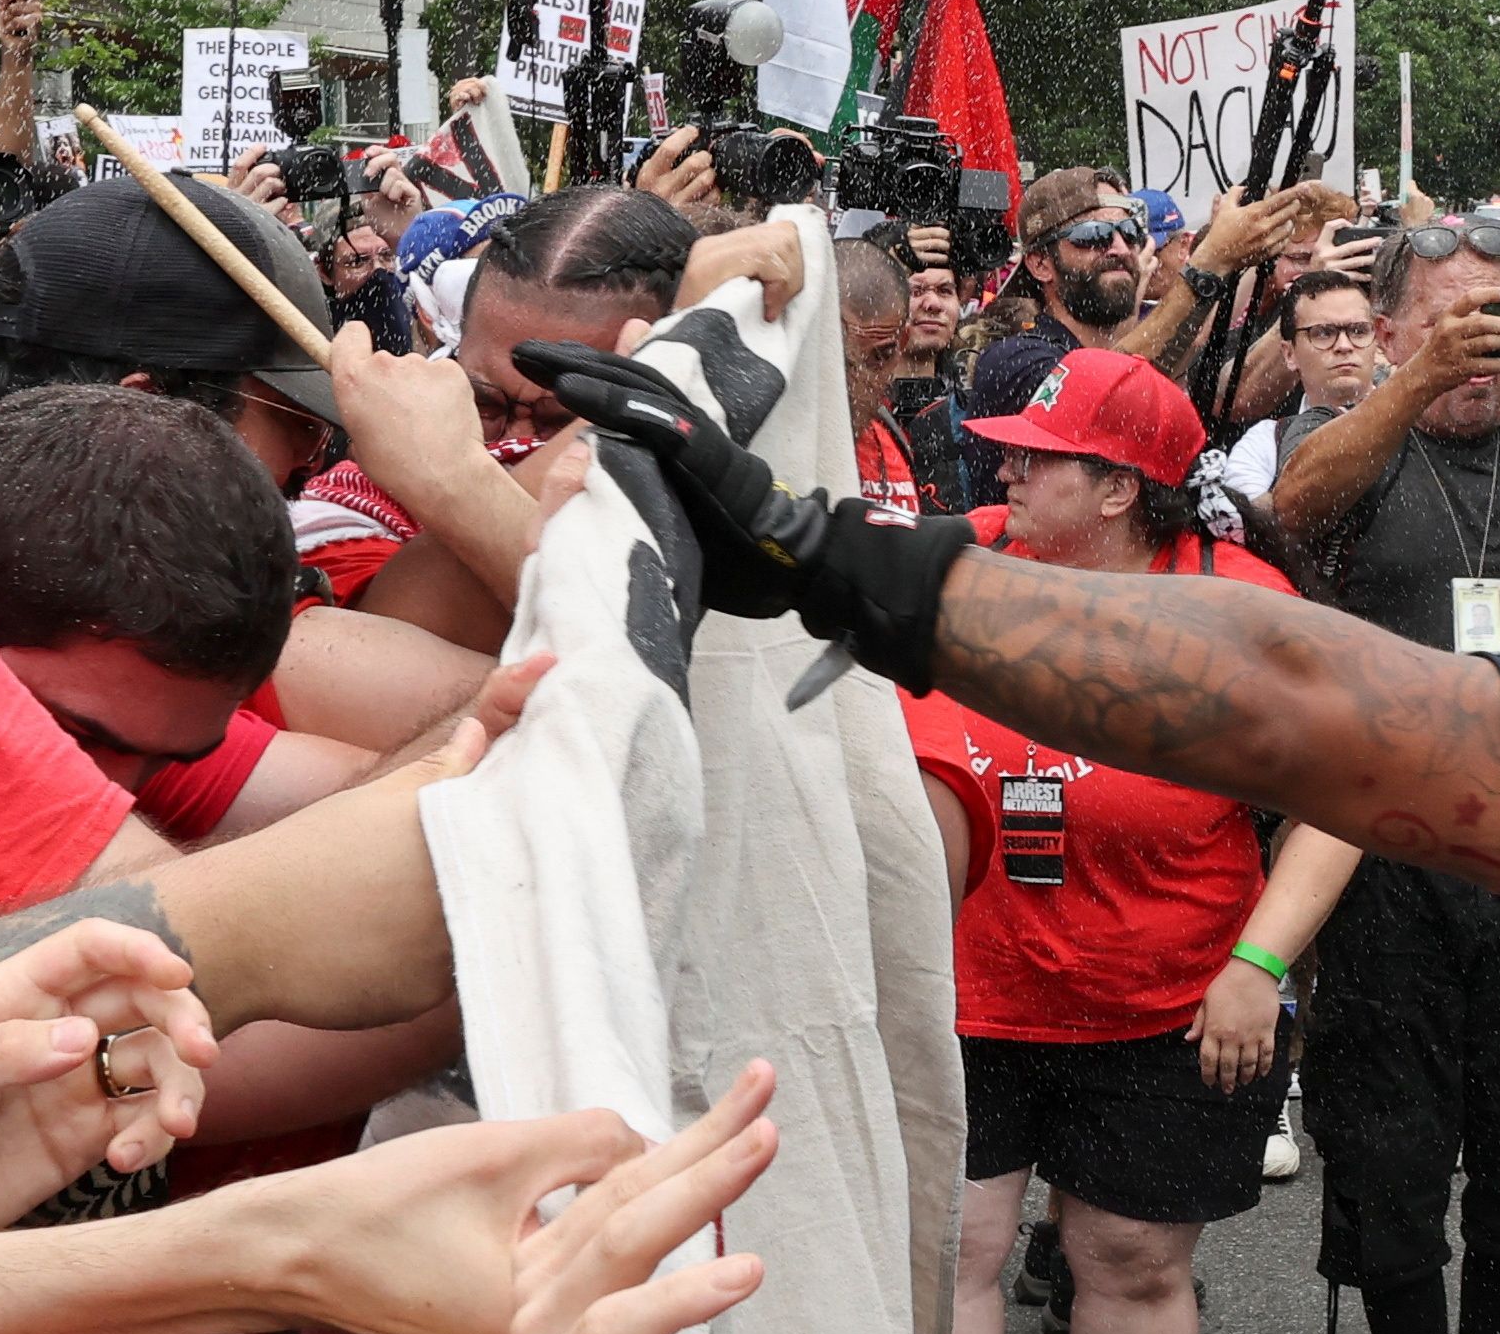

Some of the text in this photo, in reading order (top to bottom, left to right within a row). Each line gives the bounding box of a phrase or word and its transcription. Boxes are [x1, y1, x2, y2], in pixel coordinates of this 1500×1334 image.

[196, 40, 296, 57] THE PEOPLE
[1137, 24, 1220, 95] NOT
[514, 59, 566, 88] PROV
[198, 85, 272, 100] GENOCI
[211, 110, 276, 125] ARREST
[459, 197, 527, 238] BROOK
[1002, 781, 1063, 802] ARREST
[1002, 798, 1063, 813] NETANYAHU
[1003, 835, 1062, 851] SECURITY
